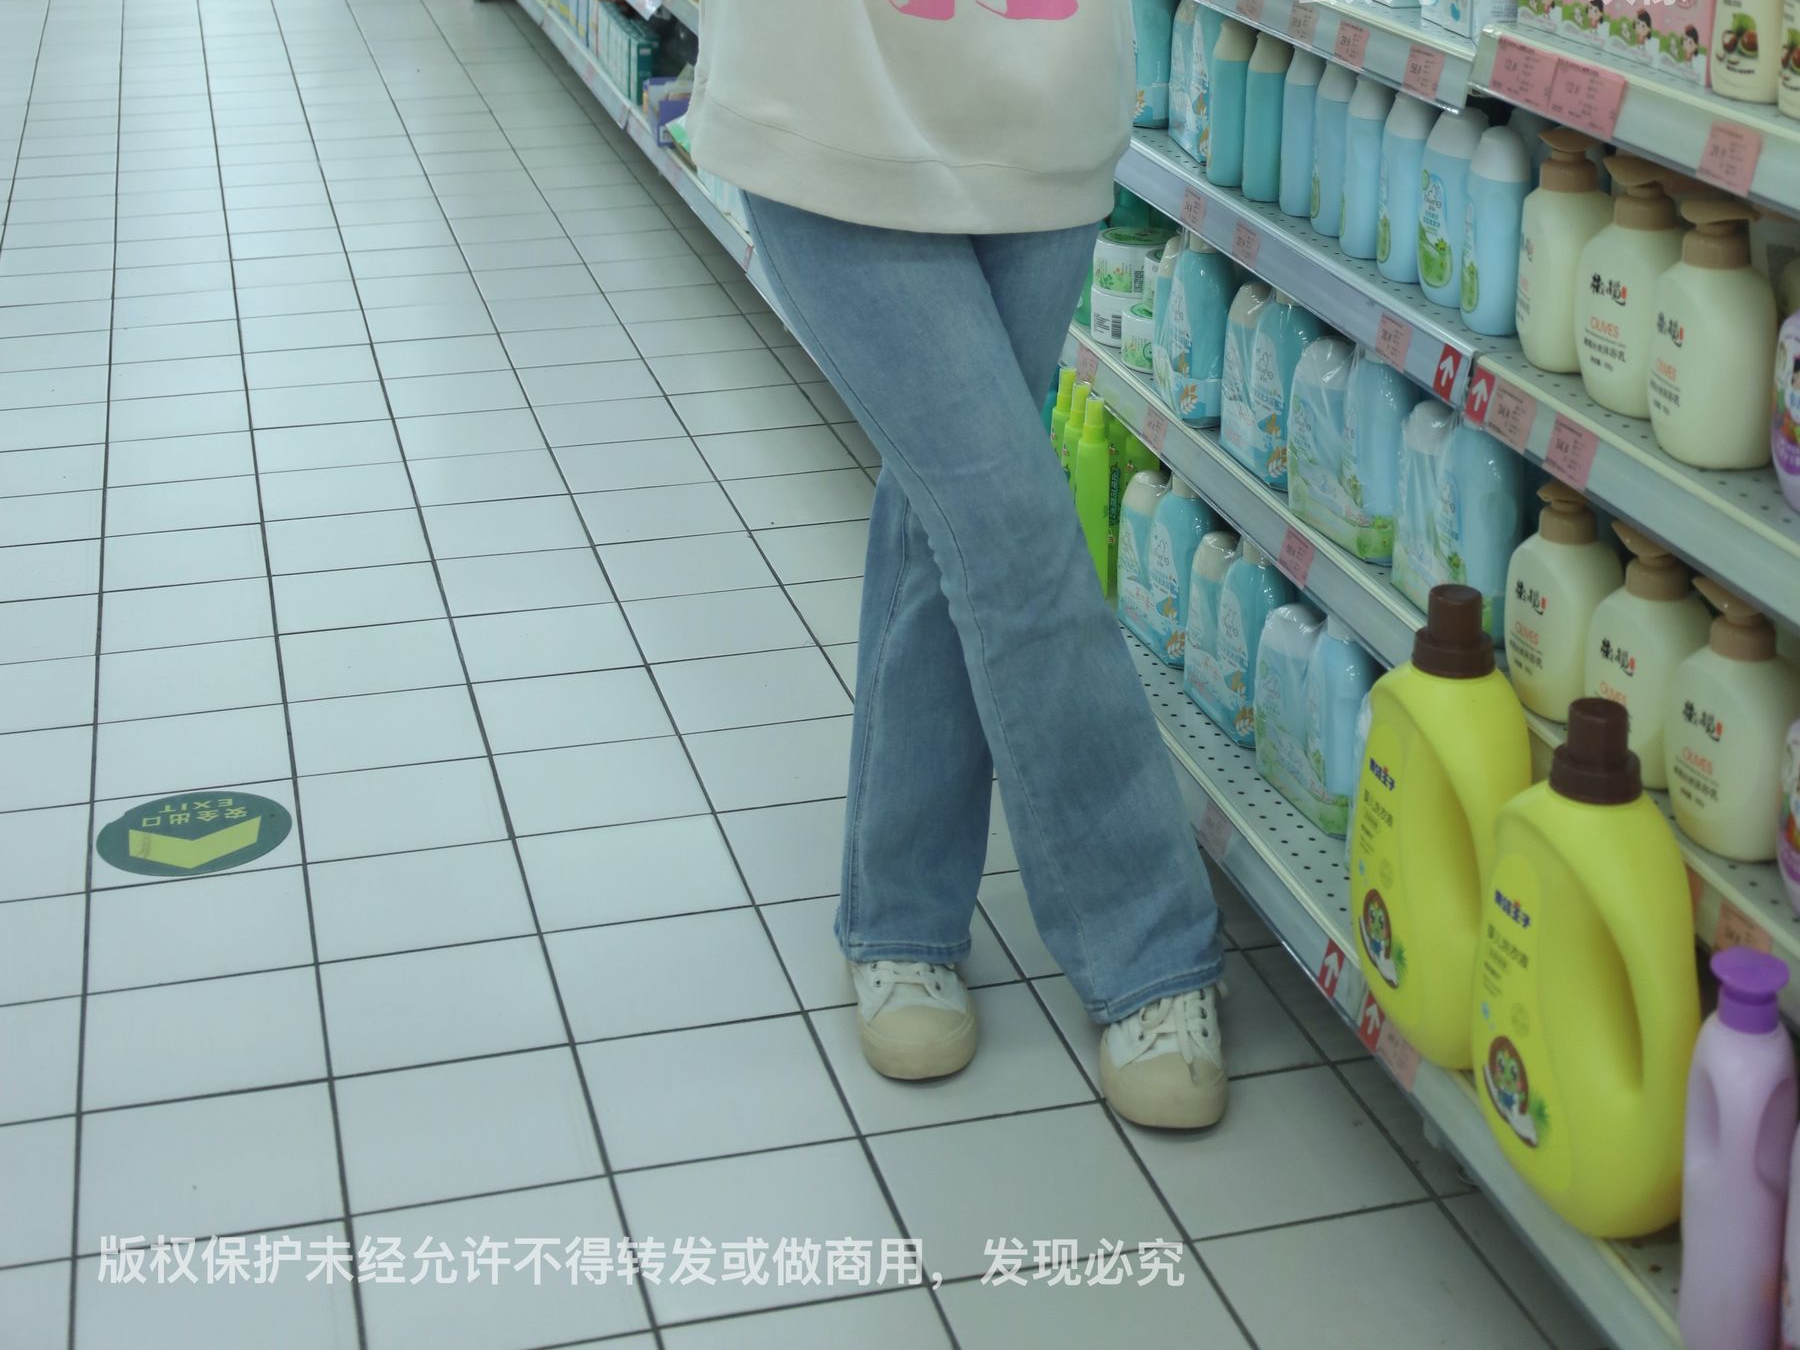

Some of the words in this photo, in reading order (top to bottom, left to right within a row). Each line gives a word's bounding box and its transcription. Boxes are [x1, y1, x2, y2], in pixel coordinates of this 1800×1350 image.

[159, 798, 233, 813] EXIT
[141, 806, 247, 827] 安全出口
